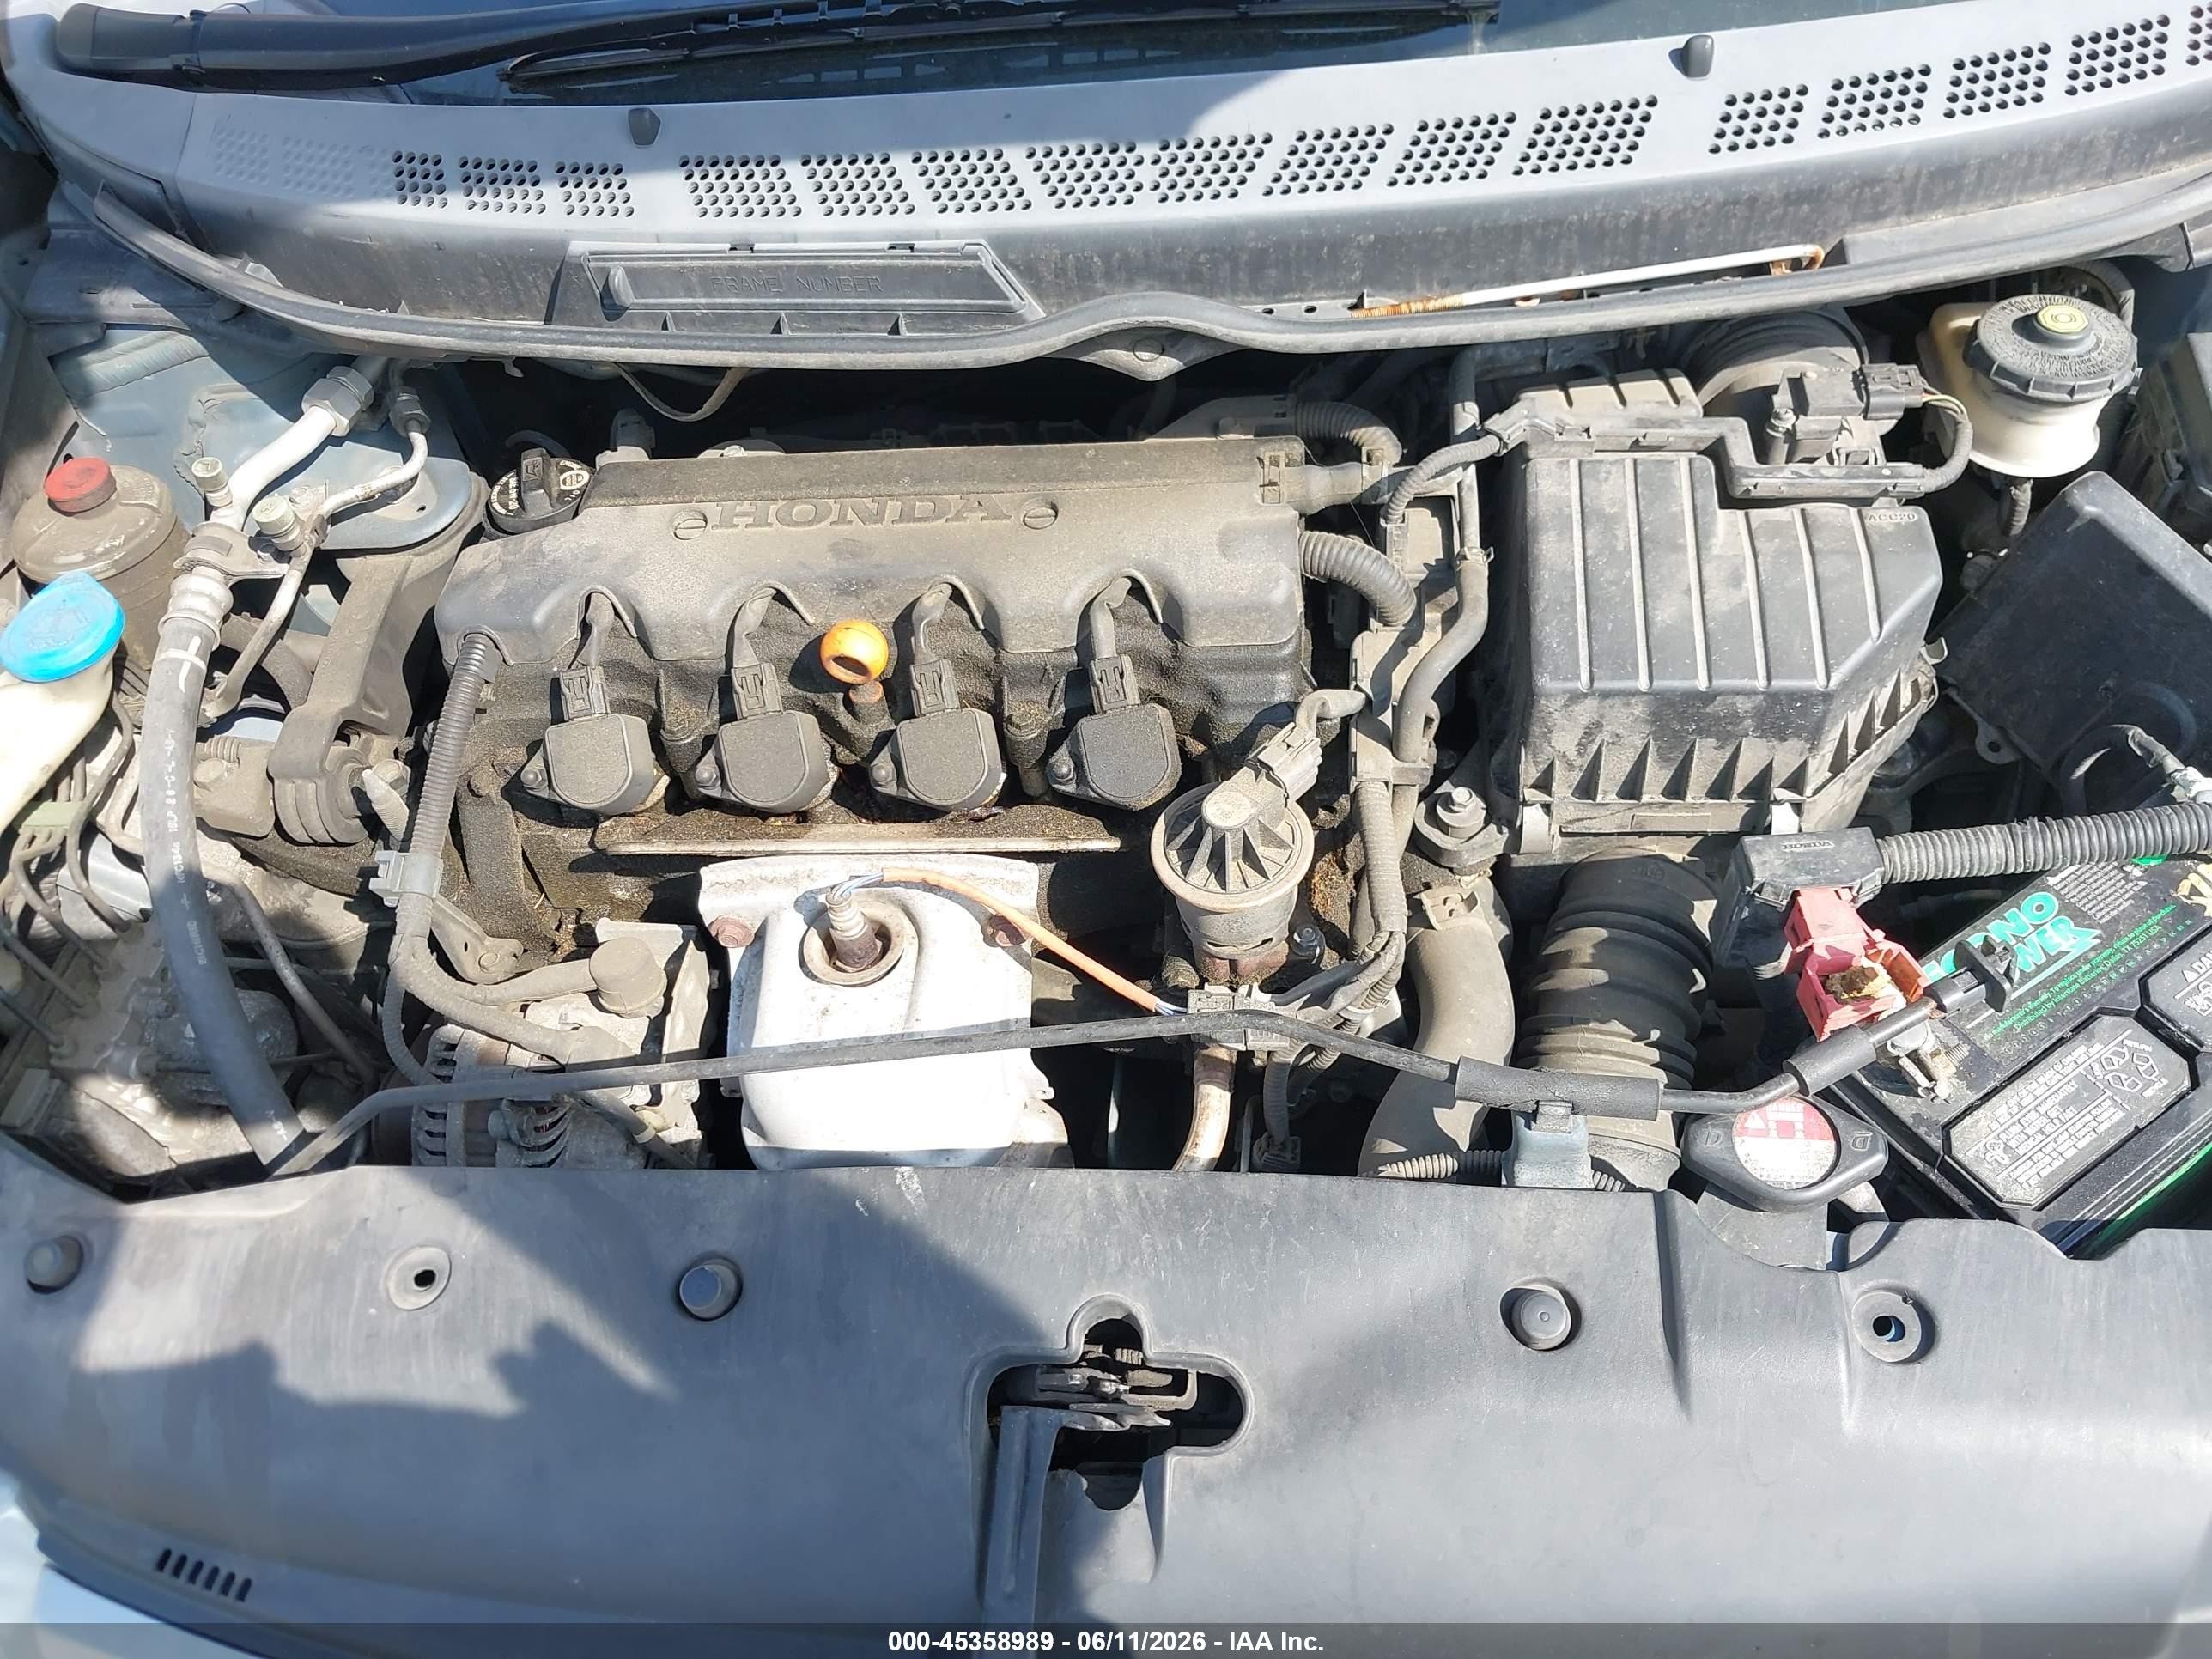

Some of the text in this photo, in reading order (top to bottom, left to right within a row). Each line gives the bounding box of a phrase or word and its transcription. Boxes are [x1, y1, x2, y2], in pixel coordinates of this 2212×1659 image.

[710, 276, 884, 293] FRAME NUMBER
[711, 495, 1012, 528] HONDA
[1782, 841, 1832, 850] HONDA
[2013, 1003, 2048, 1032] Distributed
[2051, 980, 2081, 1004] Interstate
[2077, 962, 2106, 987] Batteries,
[2103, 949, 2125, 969] Dallas,
[2130, 931, 2150, 949] 75251
[2147, 923, 2161, 936] USA
[2034, 1079, 2078, 1115] IMMEDIATELY
